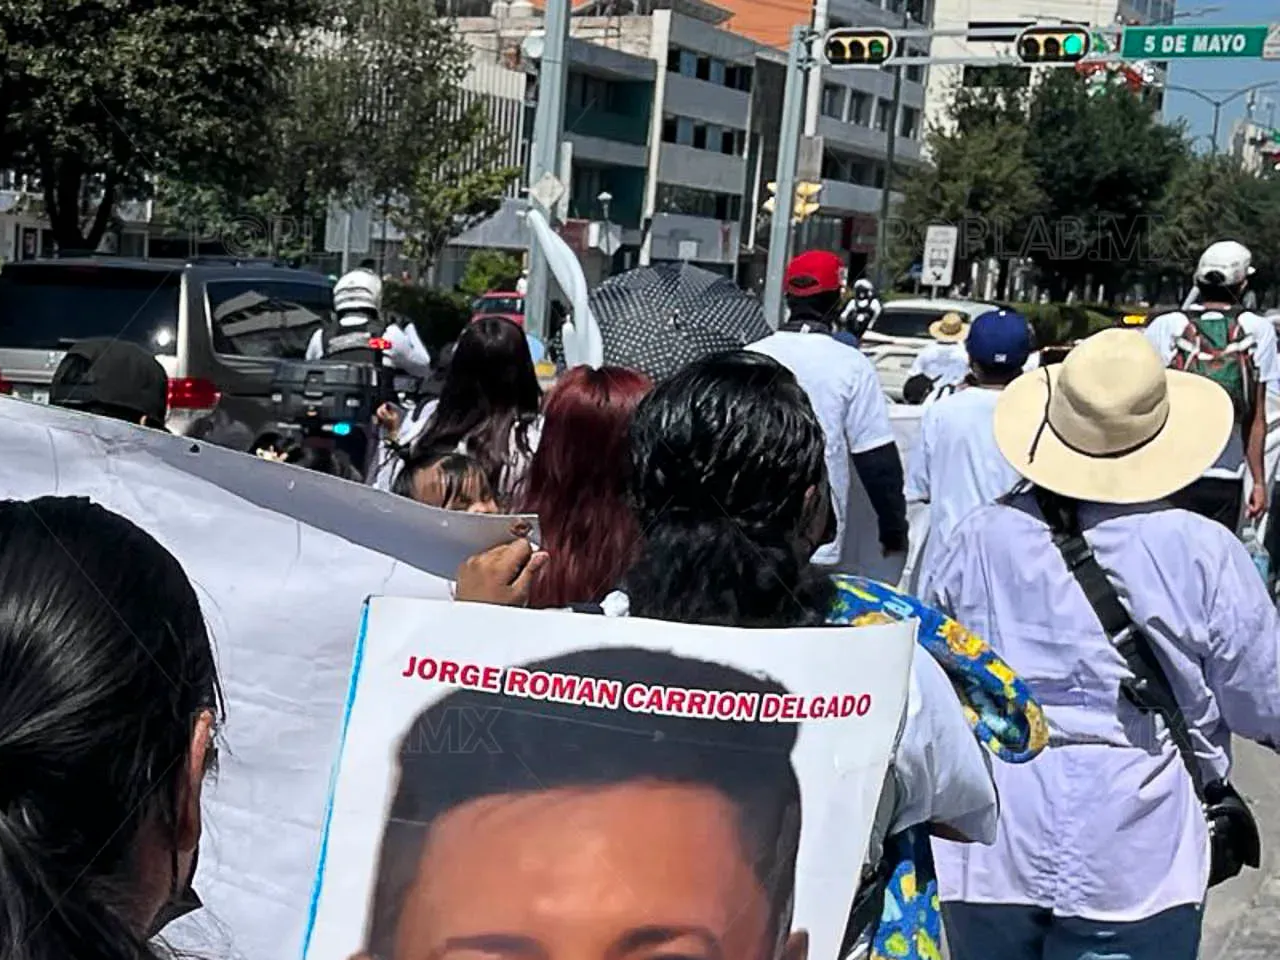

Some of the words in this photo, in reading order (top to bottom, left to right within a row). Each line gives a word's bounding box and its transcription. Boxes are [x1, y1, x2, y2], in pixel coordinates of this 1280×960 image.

[1143, 35, 1155, 53] 5
[1161, 35, 1187, 53] DE
[1192, 34, 1246, 53] MAYO
[403, 656, 500, 691] JORGE
[505, 667, 619, 707] ROMAN
[626, 683, 754, 720] CARRION
[760, 693, 872, 722] DELGADO
